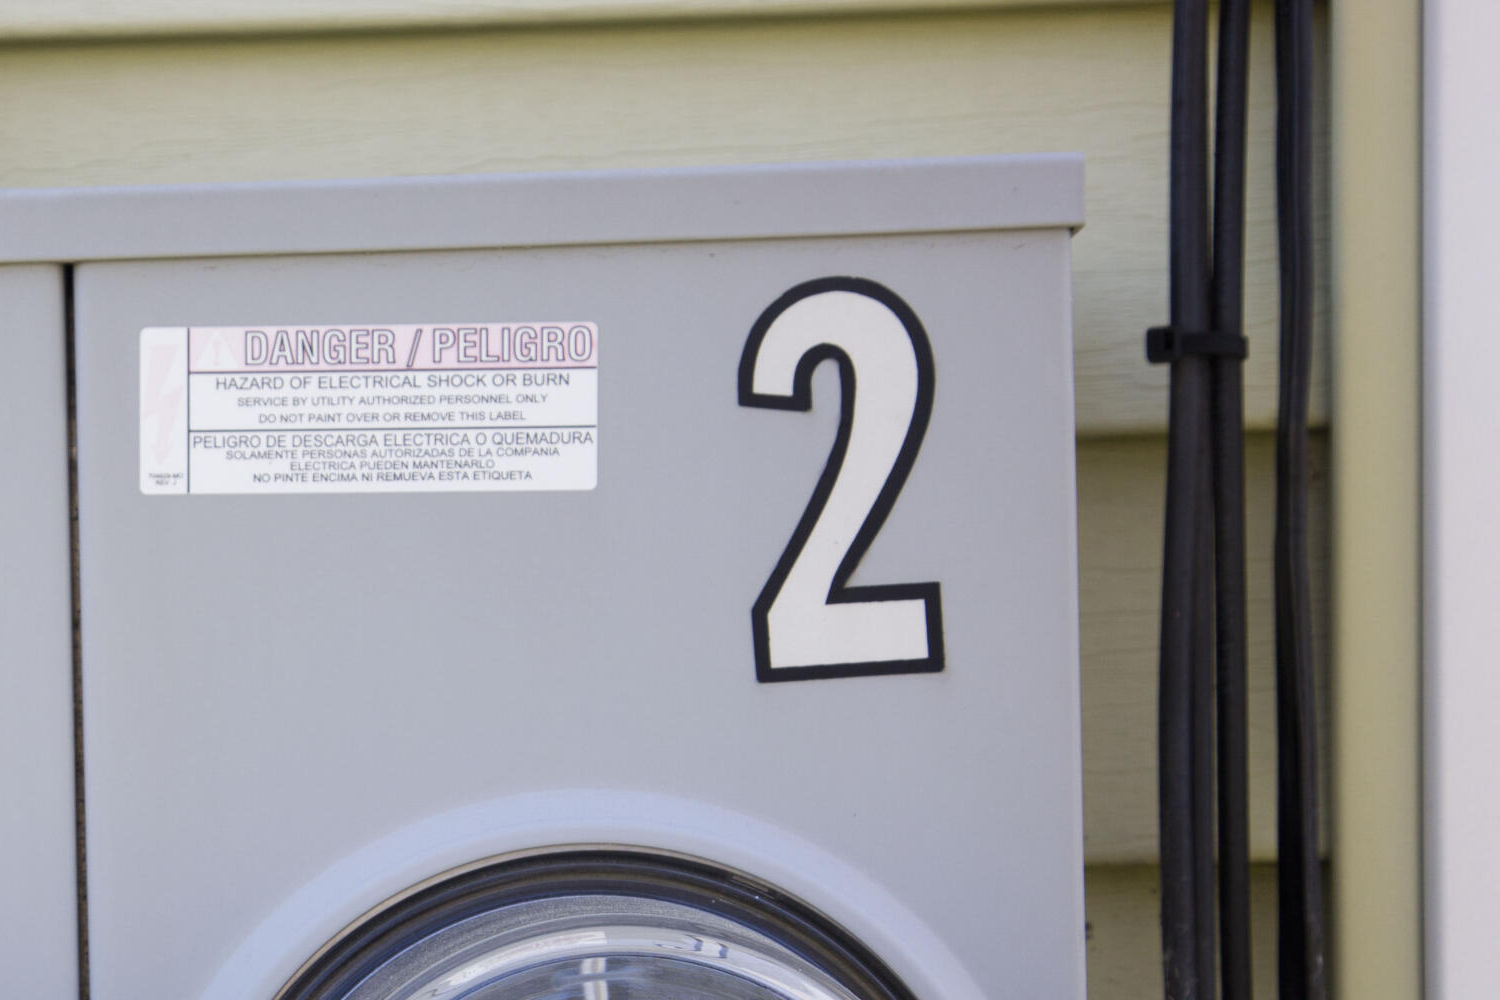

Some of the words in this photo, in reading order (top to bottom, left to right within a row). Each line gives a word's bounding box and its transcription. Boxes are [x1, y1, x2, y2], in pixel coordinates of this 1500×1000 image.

[244, 328, 396, 366] DANGER
[431, 325, 594, 363] PELIGRO
[215, 376, 284, 390] HAZARD
[289, 375, 312, 390] OF
[317, 374, 421, 389] ELECTRICAL
[426, 373, 486, 388] SHOCK
[491, 372, 517, 387] OR
[521, 372, 570, 387] BURN
[237, 396, 288, 407] SERVICE
[291, 396, 308, 407] BY
[310, 395, 355, 406] UTILITY
[358, 394, 436, 405] AUTHORIZED
[438, 393, 512, 405] PERSONNEL
[515, 393, 548, 404] ONLY
[258, 413, 276, 424] DO
[279, 413, 304, 423] NOT
[307, 412, 342, 423] PAINT
[345, 412, 380, 423] OVER
[382, 411, 401, 422] OR
[403, 411, 455, 422] REMOVE
[458, 410, 486, 421] THIS
[488, 410, 526, 421] LABEL
[192, 434, 261, 449] PELIGRO
[265, 434, 286, 448] DE
[291, 433, 379, 448] DESCARGA
[383, 432, 471, 447] ELECTRICA
[474, 431, 487, 446] O
[491, 431, 594, 446] QUEMADURA
[225, 449, 298, 460] SOLAMENTE
[301, 448, 367, 459] PERSONAS
[370, 447, 455, 458] AUTORIZADAS
[458, 447, 474, 458] DE
[478, 447, 493, 458] LA
[495, 446, 560, 457] COMPANIA
[289, 460, 356, 471] ELECTRICA
[359, 460, 409, 470] PUEDEN
[412, 459, 495, 469] MANTENARLO
[253, 473, 271, 483] NO
[273, 472, 308, 482] PINTE
[311, 472, 358, 482] ENCIMA
[361, 472, 373, 482] NI
[376, 471, 435, 482] REMUEVA
[438, 470, 470, 481] ESTA
[472, 470, 532, 481] ETIQUETA
[738, 276, 945, 682] 2
